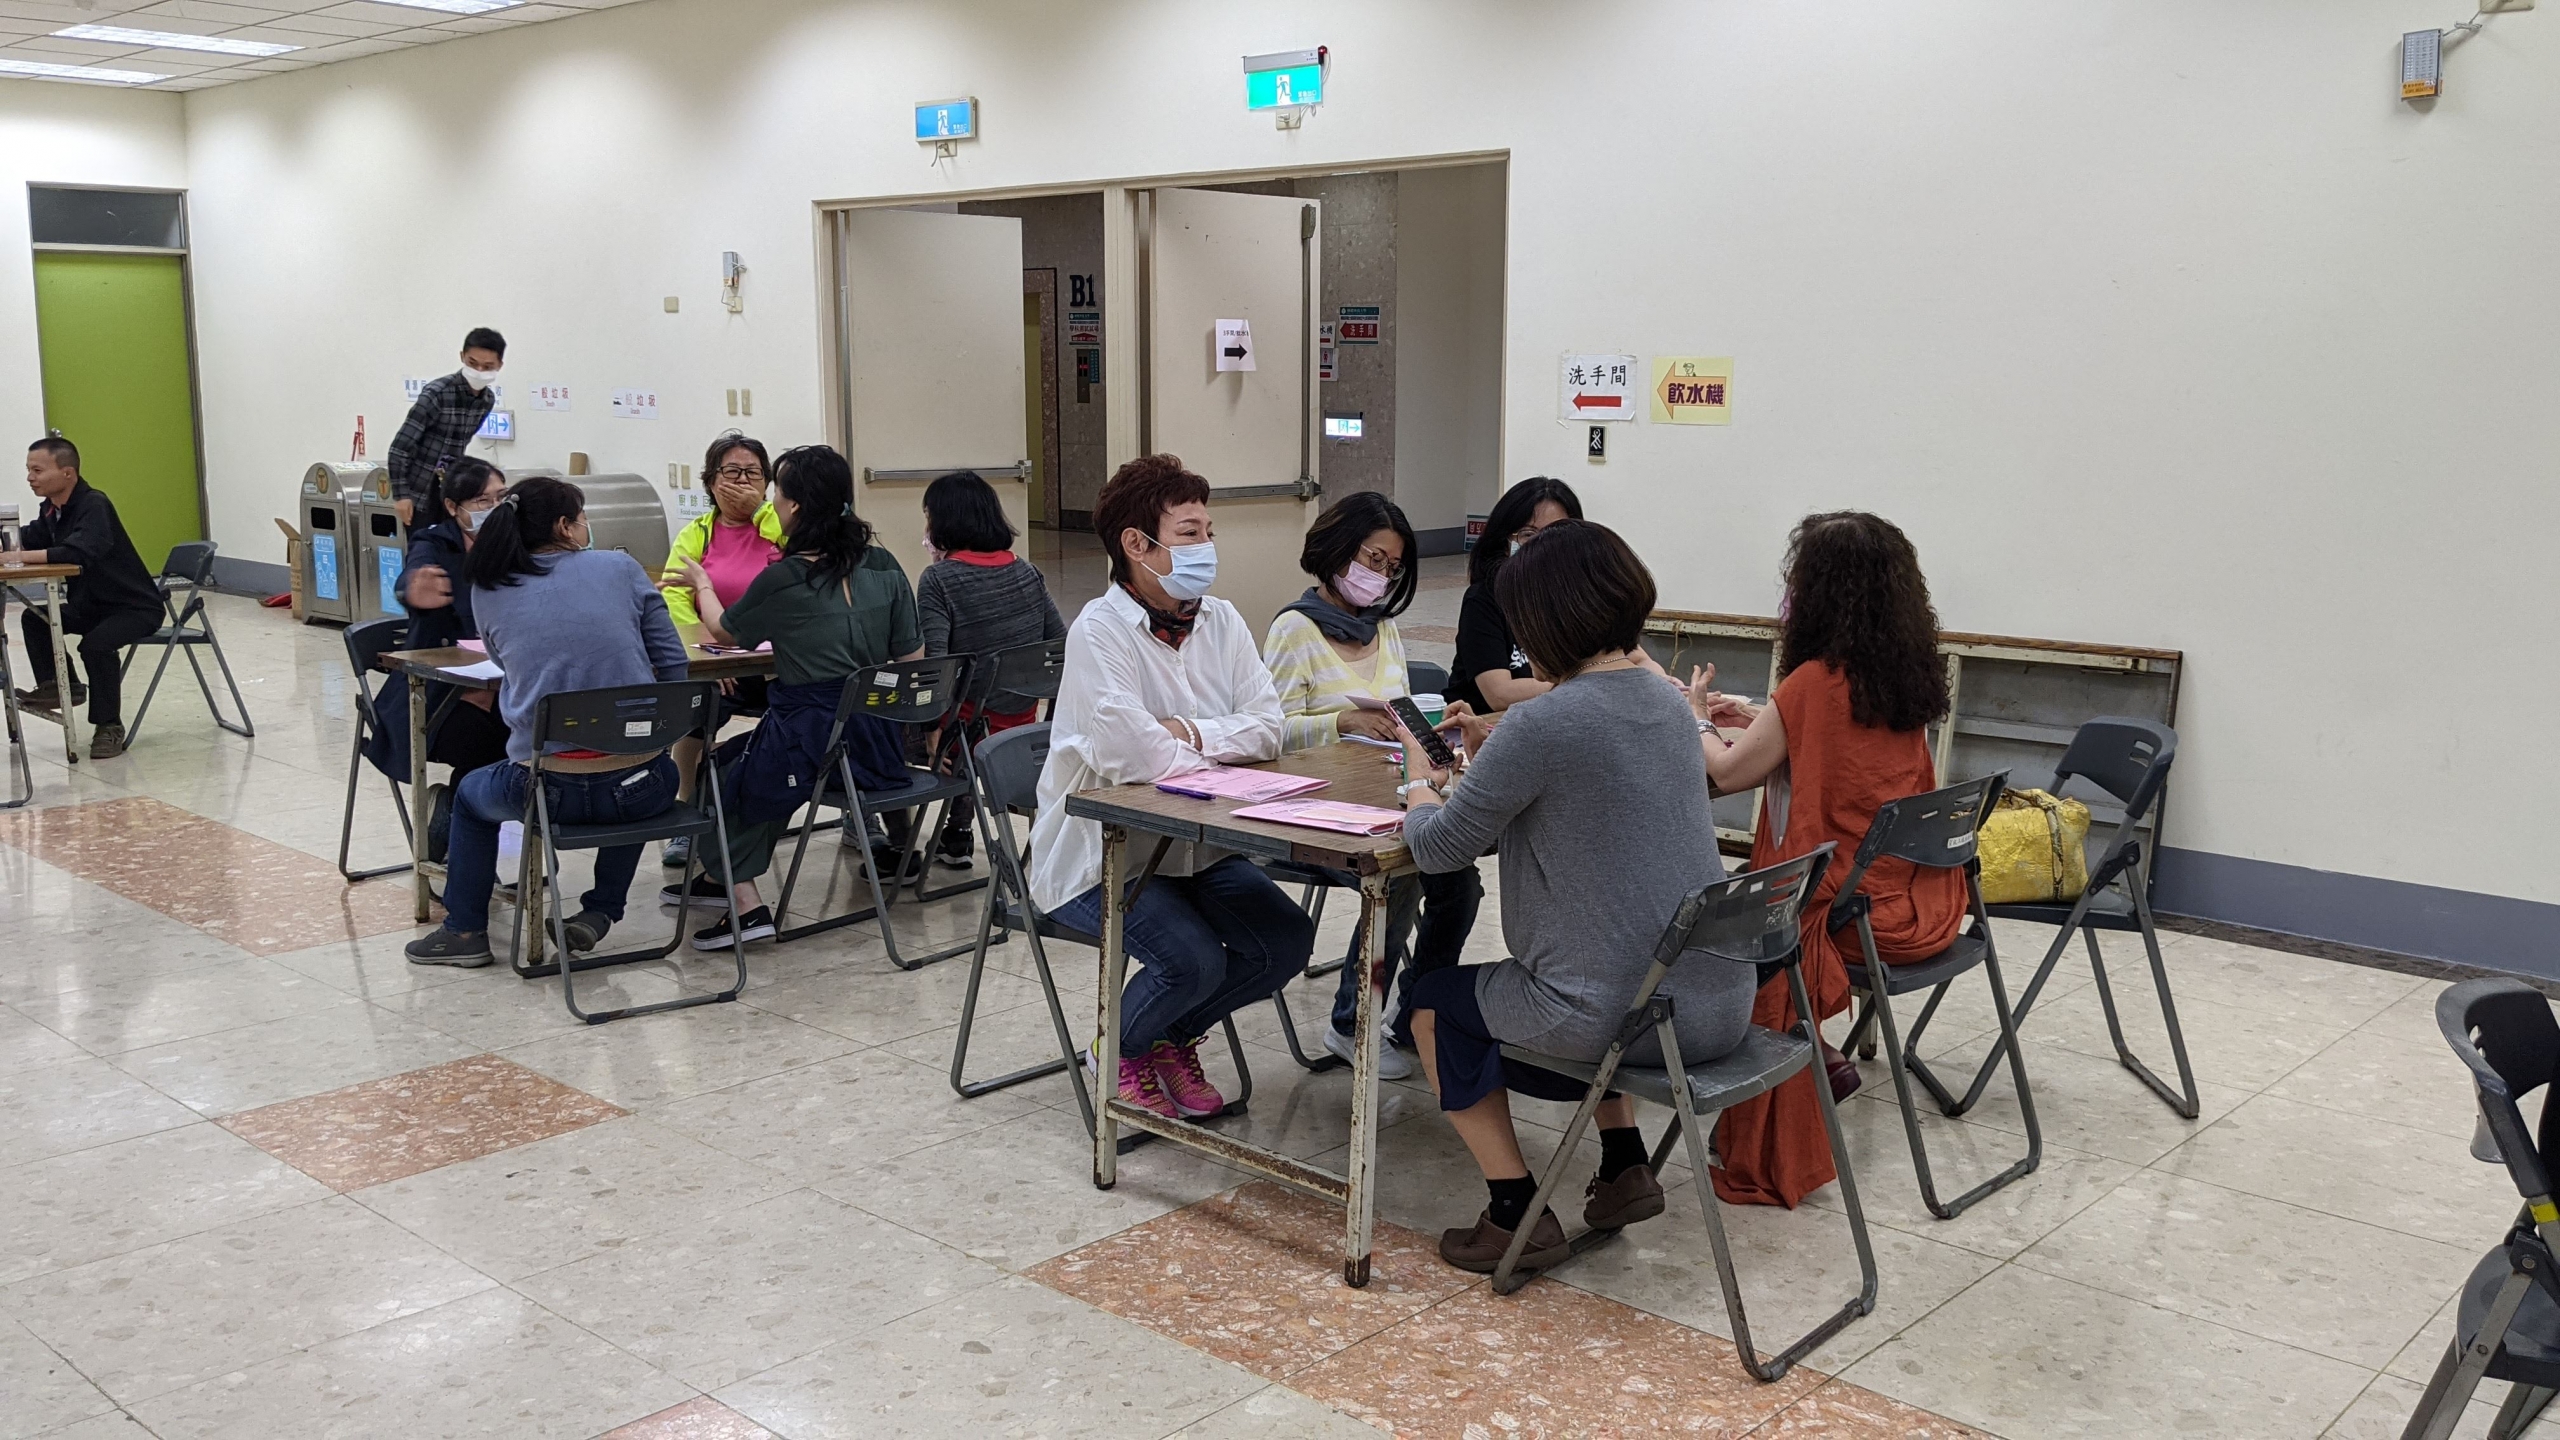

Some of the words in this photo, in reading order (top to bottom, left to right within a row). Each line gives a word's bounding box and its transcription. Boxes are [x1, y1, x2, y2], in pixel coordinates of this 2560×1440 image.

[1069, 273, 1096, 307] B1
[1350, 324, 1374, 337] 洗手間
[1568, 364, 1627, 387] 洗手間
[531, 386, 570, 400] 一般垃圾
[614, 392, 656, 408] 一般垃圾
[1667, 382, 1725, 406] 飲水機
[680, 508, 691, 516] Food
